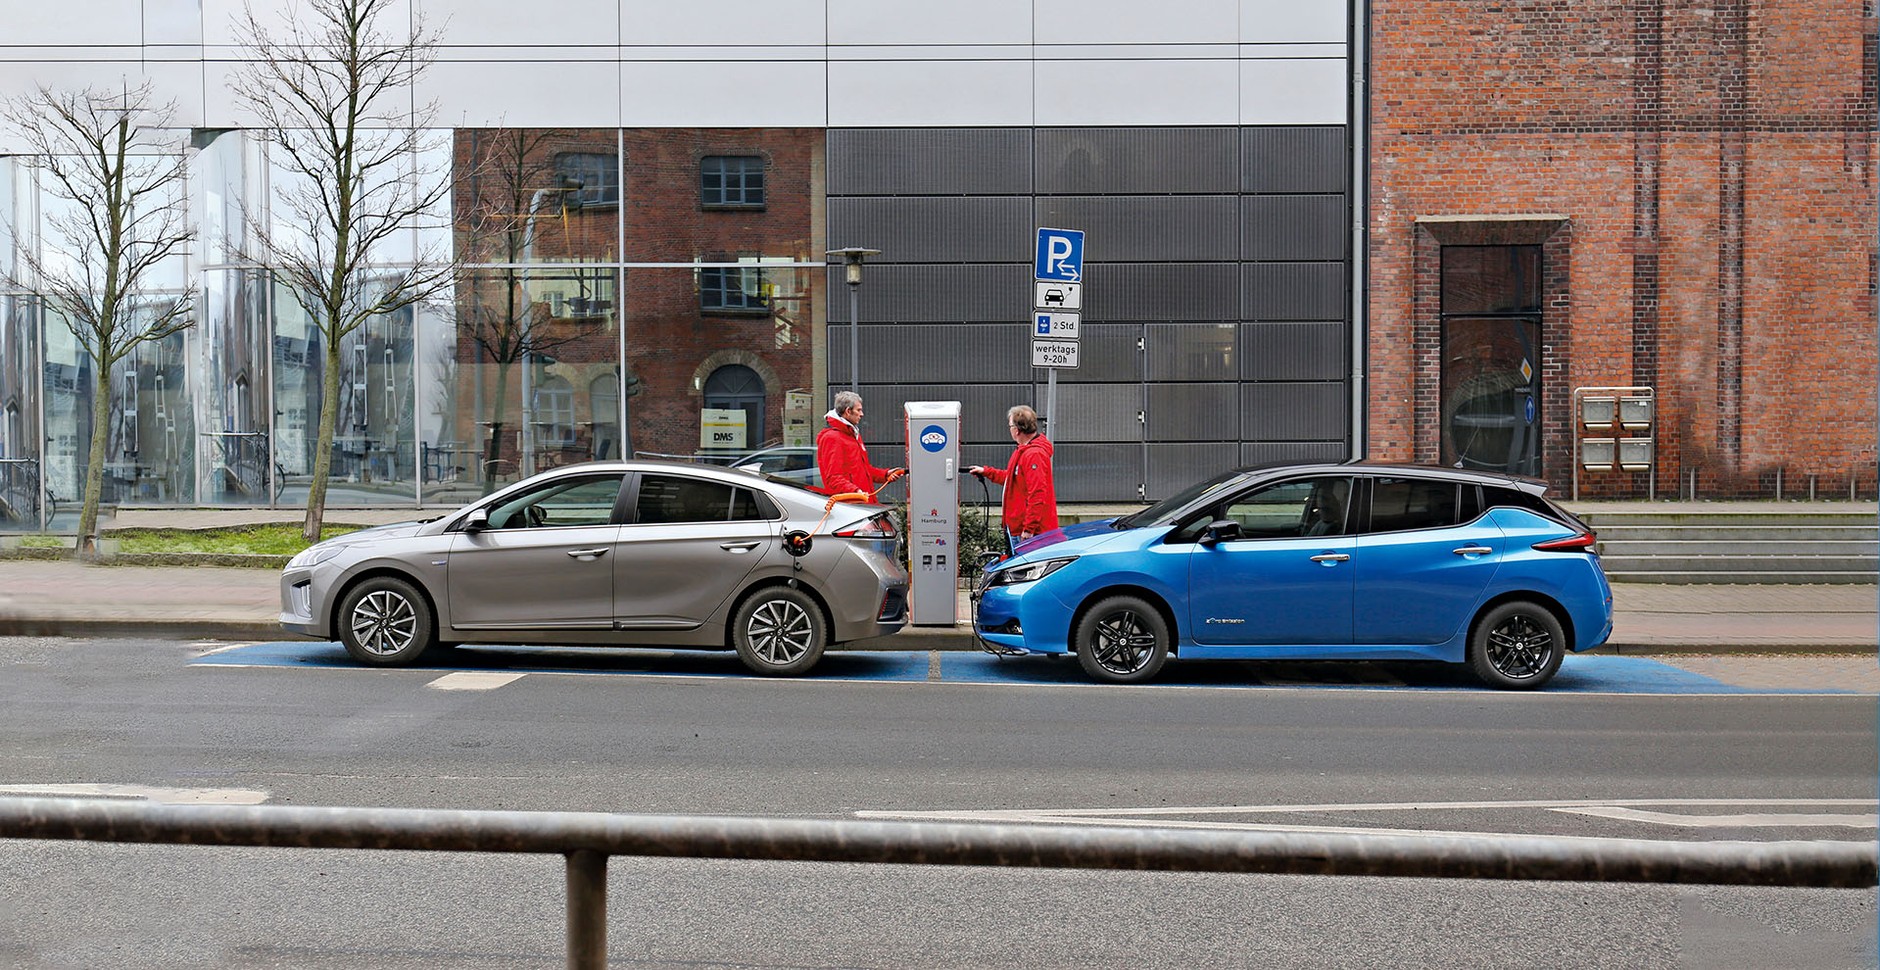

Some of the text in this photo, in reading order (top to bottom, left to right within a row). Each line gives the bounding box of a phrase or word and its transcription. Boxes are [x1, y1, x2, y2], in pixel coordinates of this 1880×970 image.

[1047, 235, 1072, 273] P
[1060, 321, 1076, 330] Std.
[1035, 344, 1076, 355] werktags
[1043, 354, 1068, 364] 9-20h
[713, 432, 734, 441] DMS
